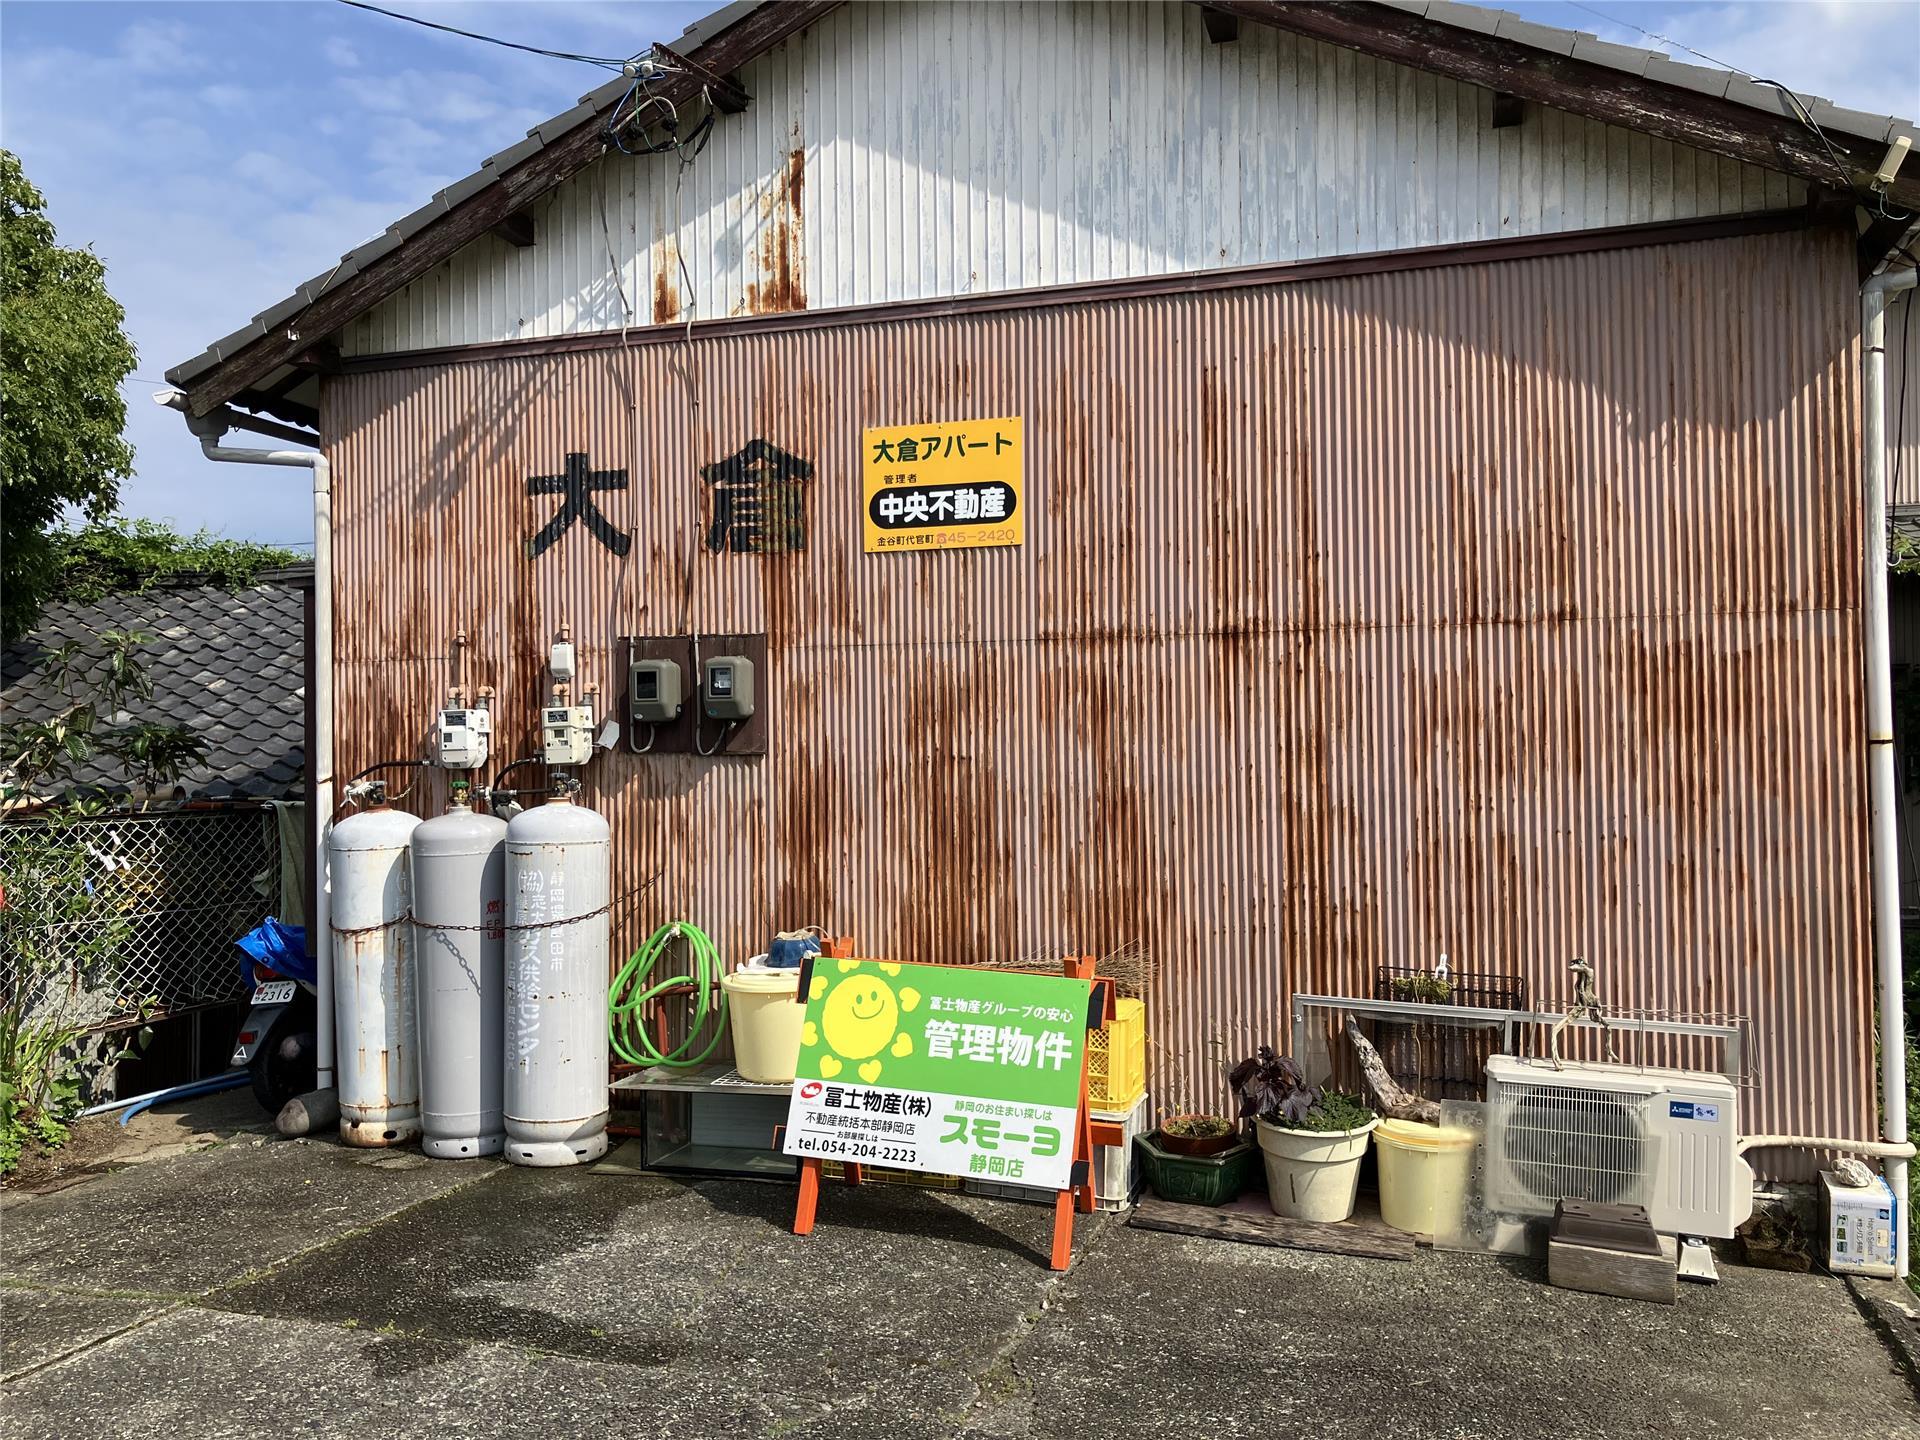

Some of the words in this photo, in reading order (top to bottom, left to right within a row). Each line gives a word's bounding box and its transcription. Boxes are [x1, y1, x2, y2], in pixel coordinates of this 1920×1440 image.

[873, 432, 1013, 464] 大倉アパート
[884, 473, 918, 485] 管理者
[879, 486, 1006, 524] 中央不動産
[877, 534, 935, 547] 金谷町代官町
[261, 988, 292, 1001] 2316
[924, 1018, 1073, 1071] 管理物件
[954, 1100, 1053, 1121] 静岡のお住まい探しは
[805, 1111, 916, 1136] 不動産統括本部静岡店
[939, 1114, 1061, 1157] スモーヨ
[836, 1131, 879, 1143] お部屋探しは
[798, 1137, 917, 1163] tel.054-204-2223
[968, 1153, 1025, 1178] 静岡店
